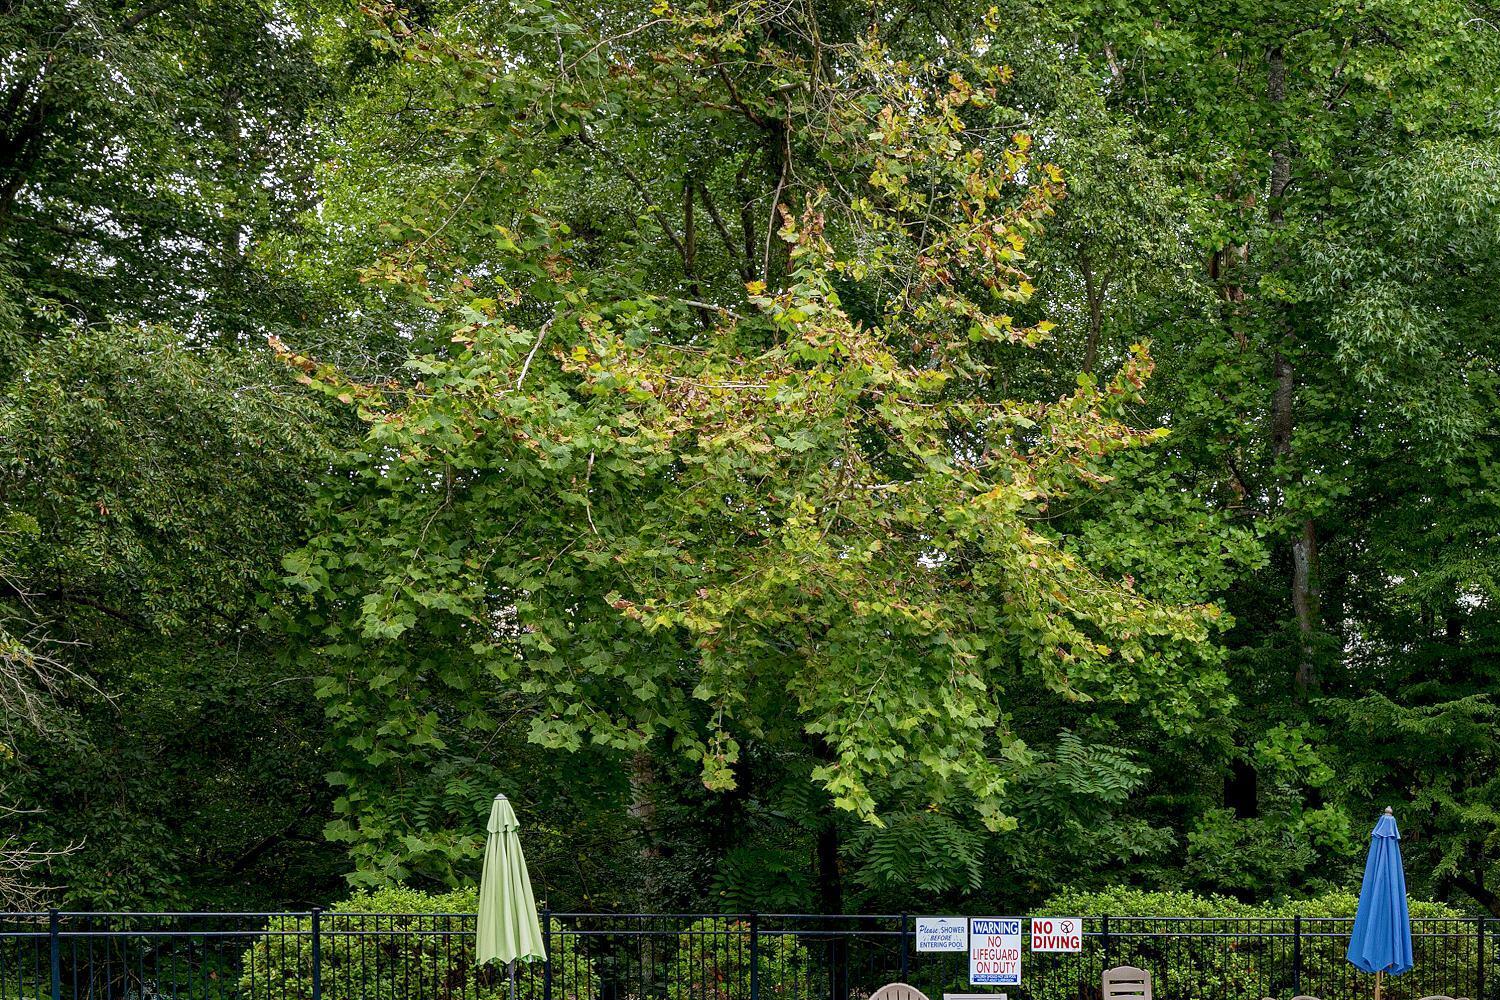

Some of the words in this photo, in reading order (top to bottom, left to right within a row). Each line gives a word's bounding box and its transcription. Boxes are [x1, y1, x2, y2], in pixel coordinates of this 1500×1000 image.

[920, 925, 938, 934] Please
[973, 922, 1018, 934] WARNING
[1034, 921, 1052, 934] NO
[987, 936, 1002, 947] NO
[1033, 936, 1080, 948] DIVING
[973, 949, 1018, 960] LIFEGUARD
[976, 962, 990, 973] ON
[993, 962, 1016, 973] DUTY
